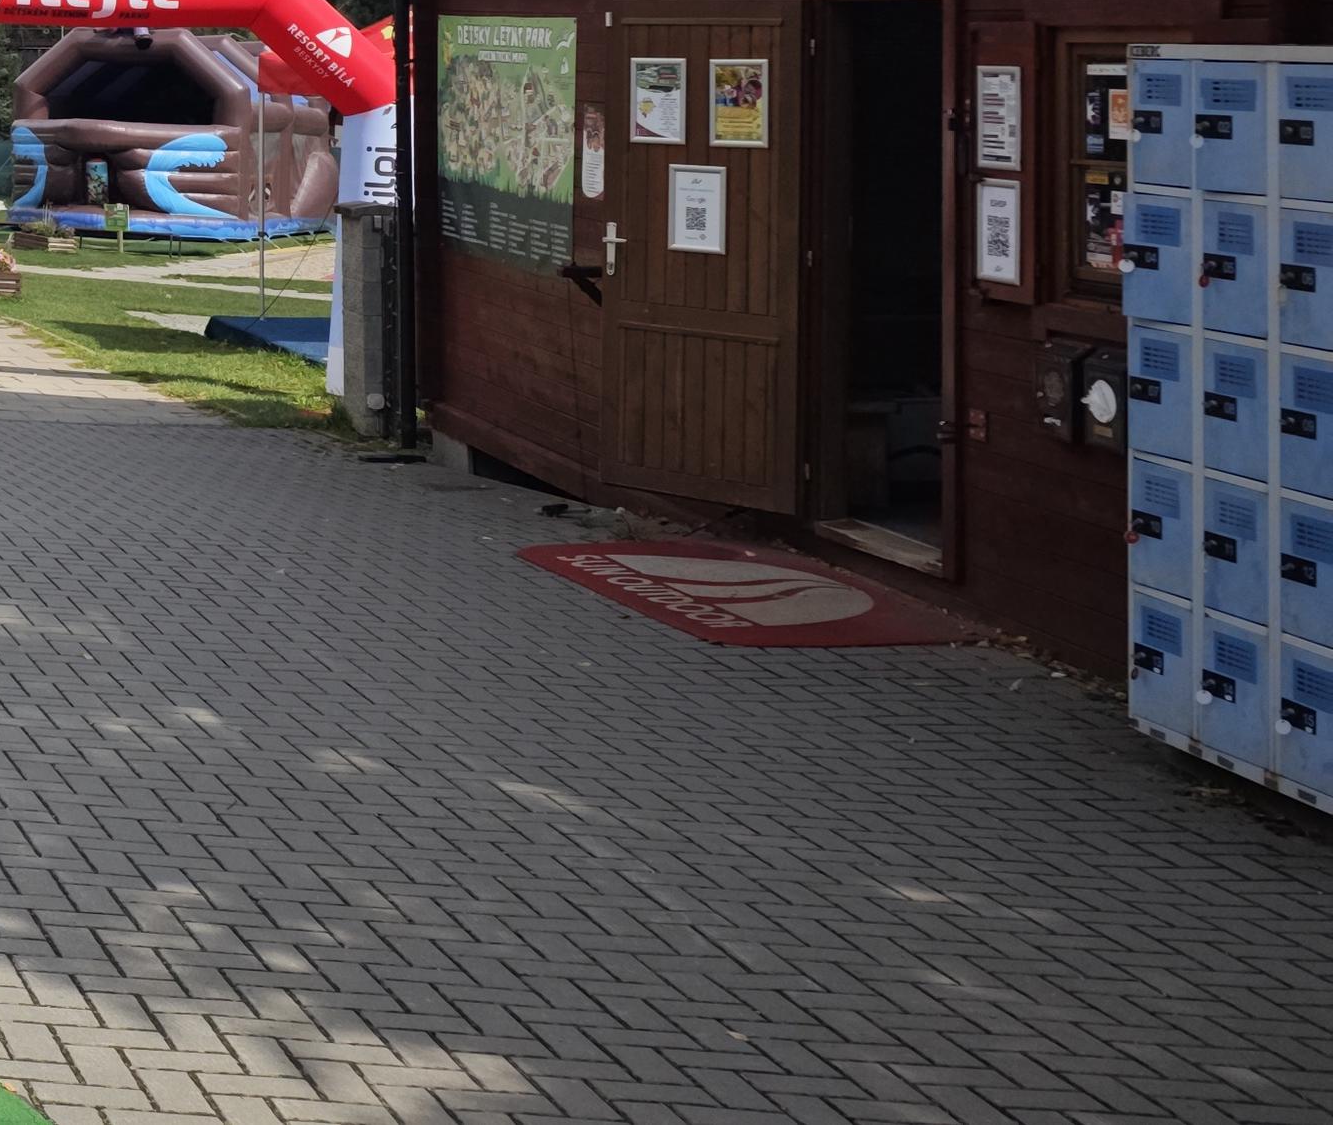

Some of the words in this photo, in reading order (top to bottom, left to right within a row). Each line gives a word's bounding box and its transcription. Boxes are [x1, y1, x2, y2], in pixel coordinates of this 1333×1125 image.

[287, 23, 331, 62] RESORT
[328, 62, 356, 88] BÍLÁ
[293, 46, 330, 79] BESKYDY
[361, 145, 397, 205] ilpi
[1303, 713, 1315, 727] 15
